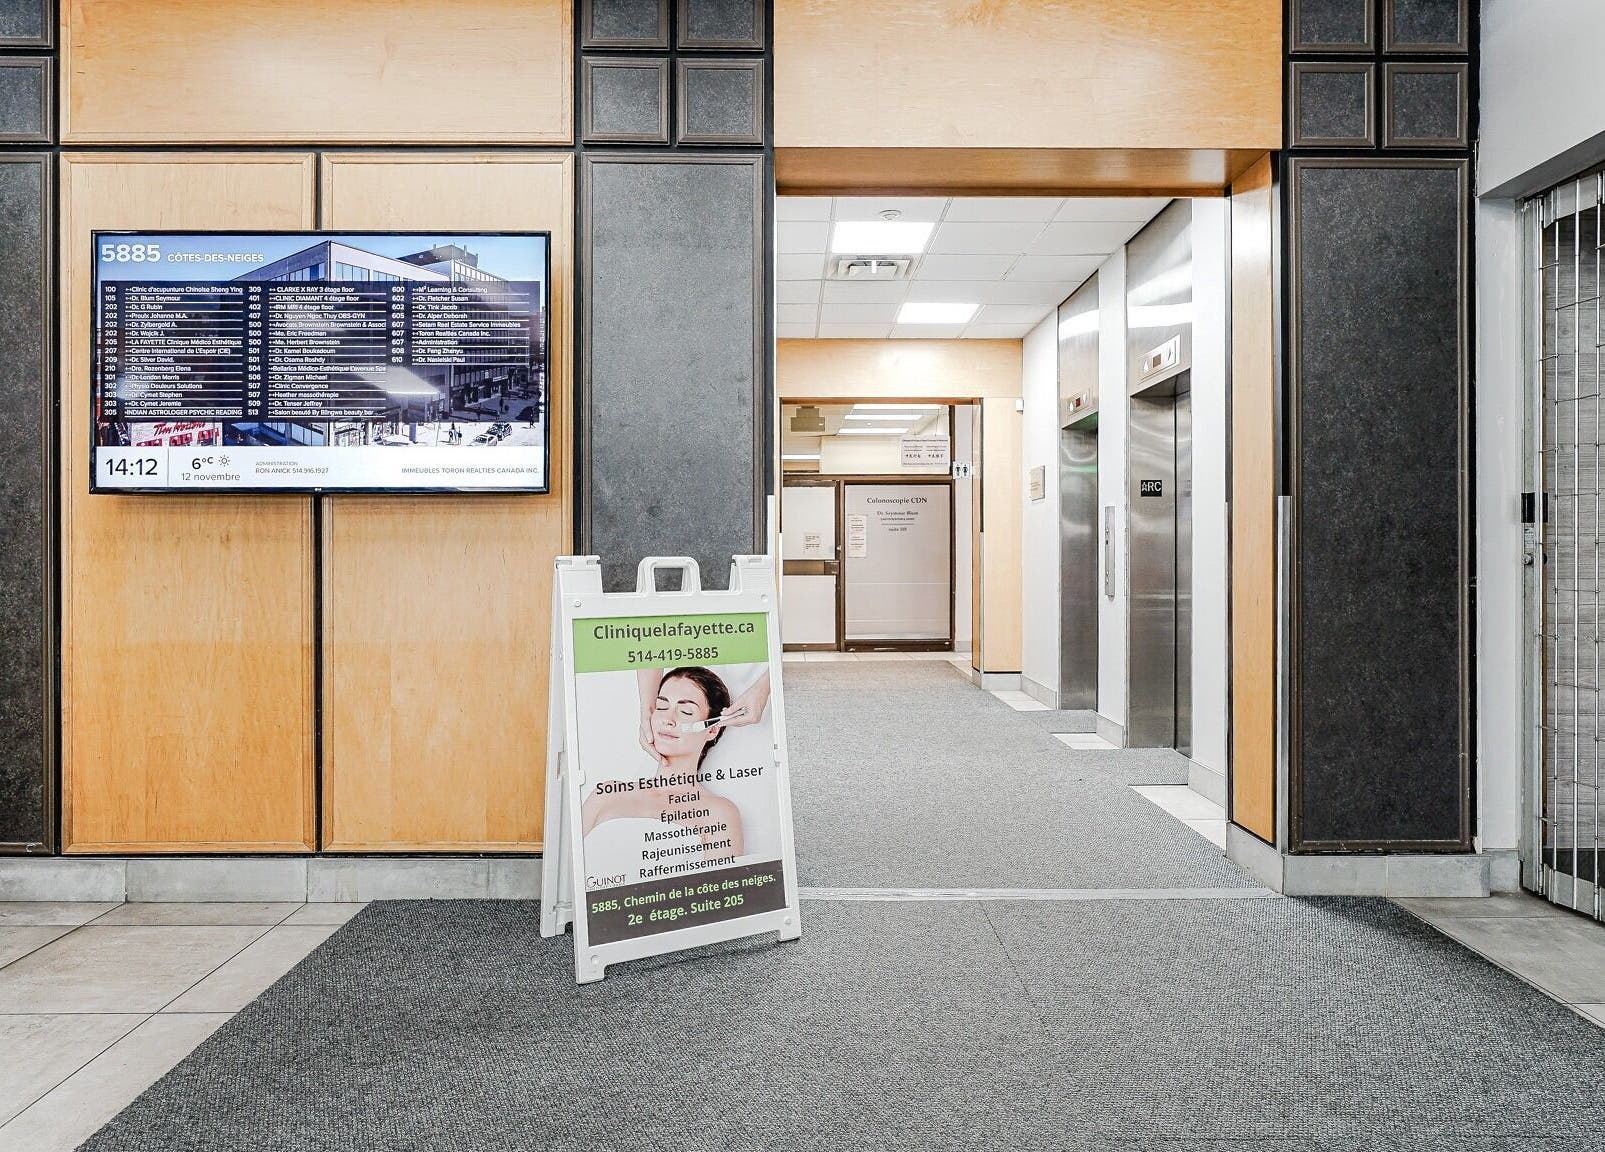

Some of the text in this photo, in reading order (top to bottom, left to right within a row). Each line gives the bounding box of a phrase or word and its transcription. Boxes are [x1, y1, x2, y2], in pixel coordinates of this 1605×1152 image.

[101, 244, 264, 262] 5885 CÔTES-DES-NEIGES
[167, 339, 188, 347] Clinique
[106, 458, 158, 476] 14:12
[182, 473, 241, 481] 12 novembre
[593, 622, 755, 641] Cliniquelafayette.ca
[627, 647, 719, 663] 514-419-5885
[596, 766, 763, 795] Soins Esthétique & Laser
[668, 791, 700, 804] Facial
[660, 807, 710, 824] Épilation
[644, 822, 727, 842] Massothérapie
[642, 838, 731, 862] Rajeunissement
[639, 855, 735, 878] Raffermissement
[592, 899, 621, 913] 5885,
[624, 887, 666, 907] Chemin
[669, 887, 681, 899] de
[685, 885, 694, 896] la
[697, 882, 719, 894] côte
[722, 878, 739, 890] des
[628, 894, 744, 925] 2e étage. Suite 205
